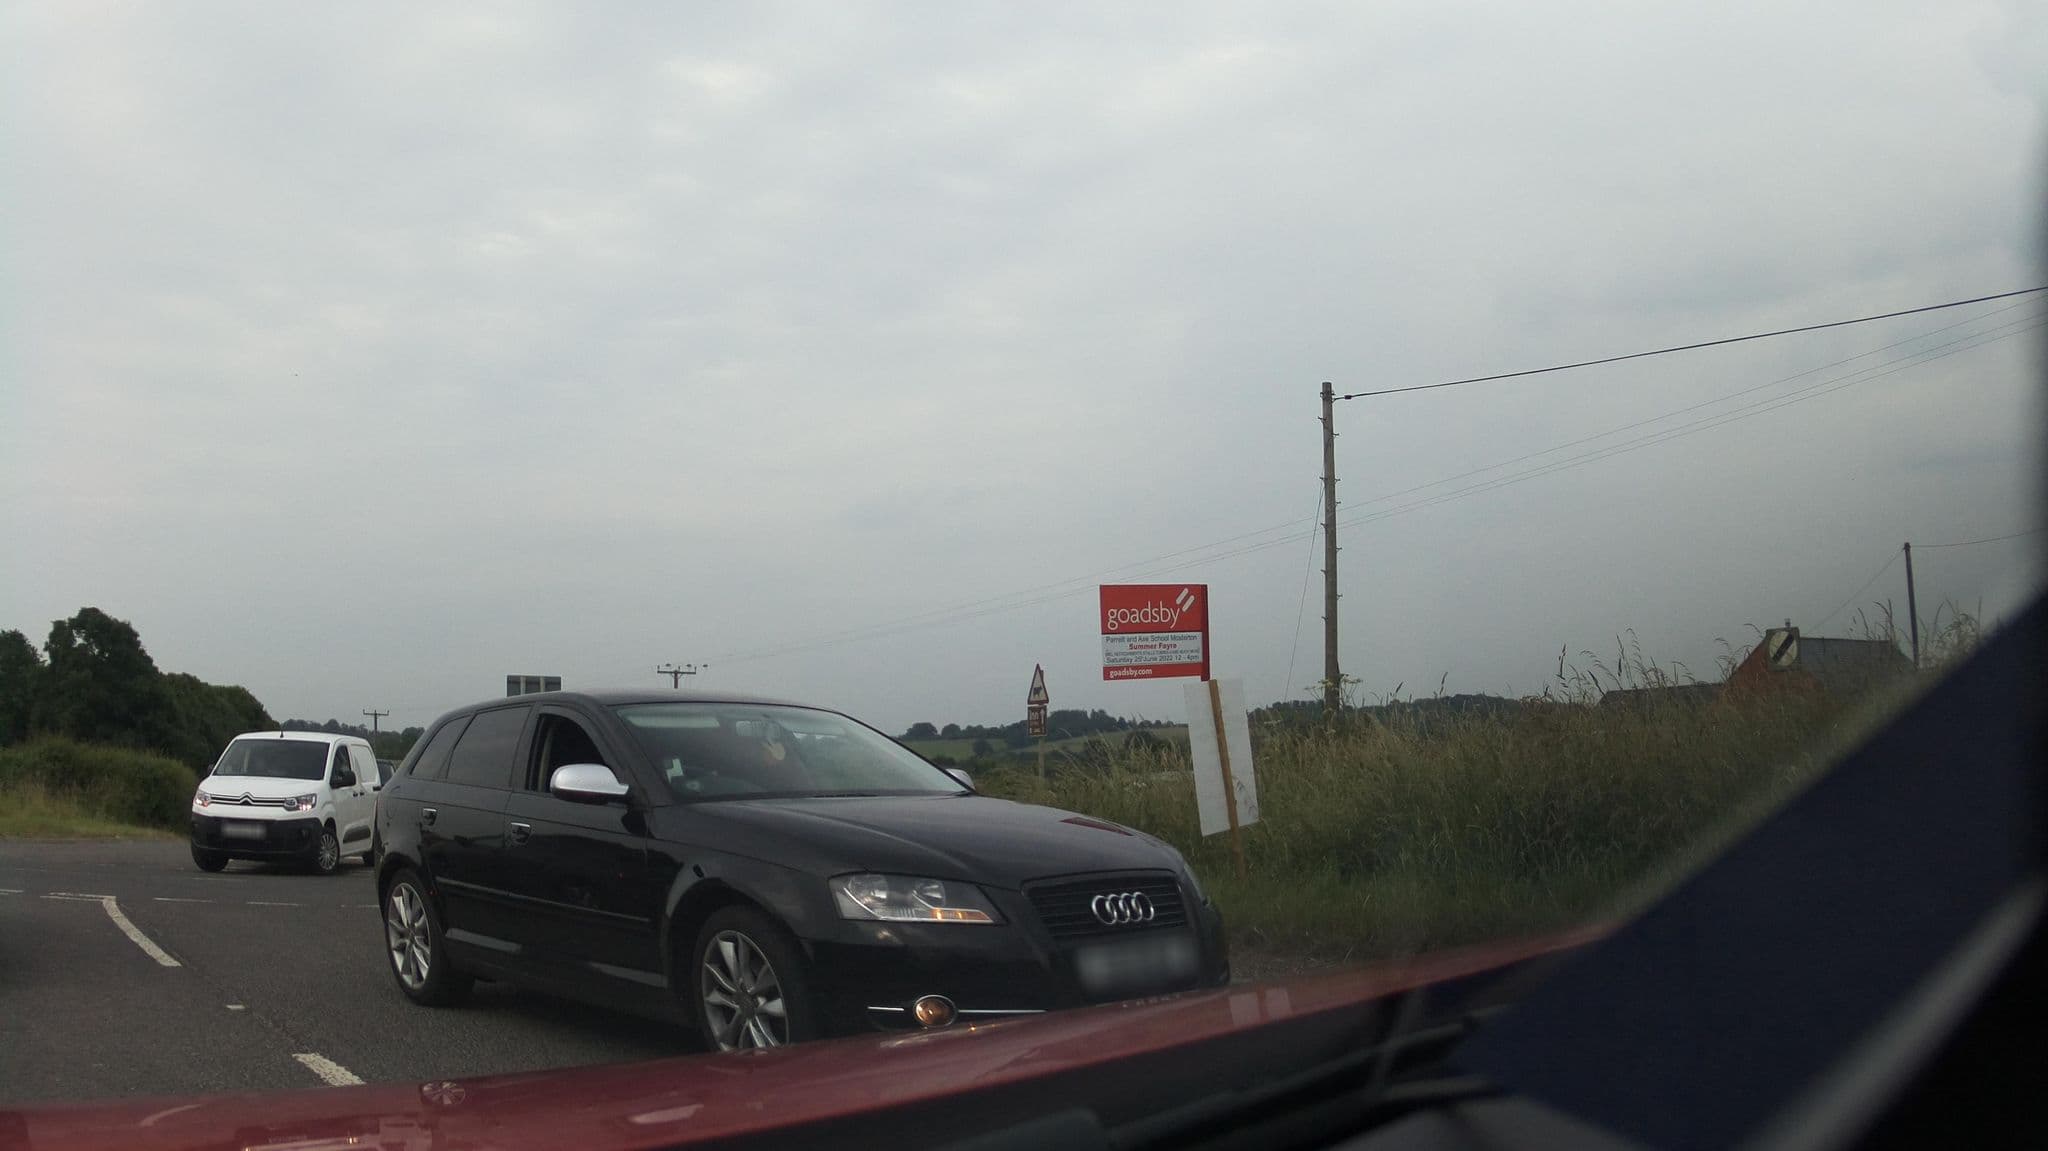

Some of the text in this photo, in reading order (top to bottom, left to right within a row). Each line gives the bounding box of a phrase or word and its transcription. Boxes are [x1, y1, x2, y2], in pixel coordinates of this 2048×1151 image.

[1107, 600, 1180, 630] goadsby
[1106, 656, 1133, 664] Saturday
[1109, 667, 1153, 679] goadsby.com
